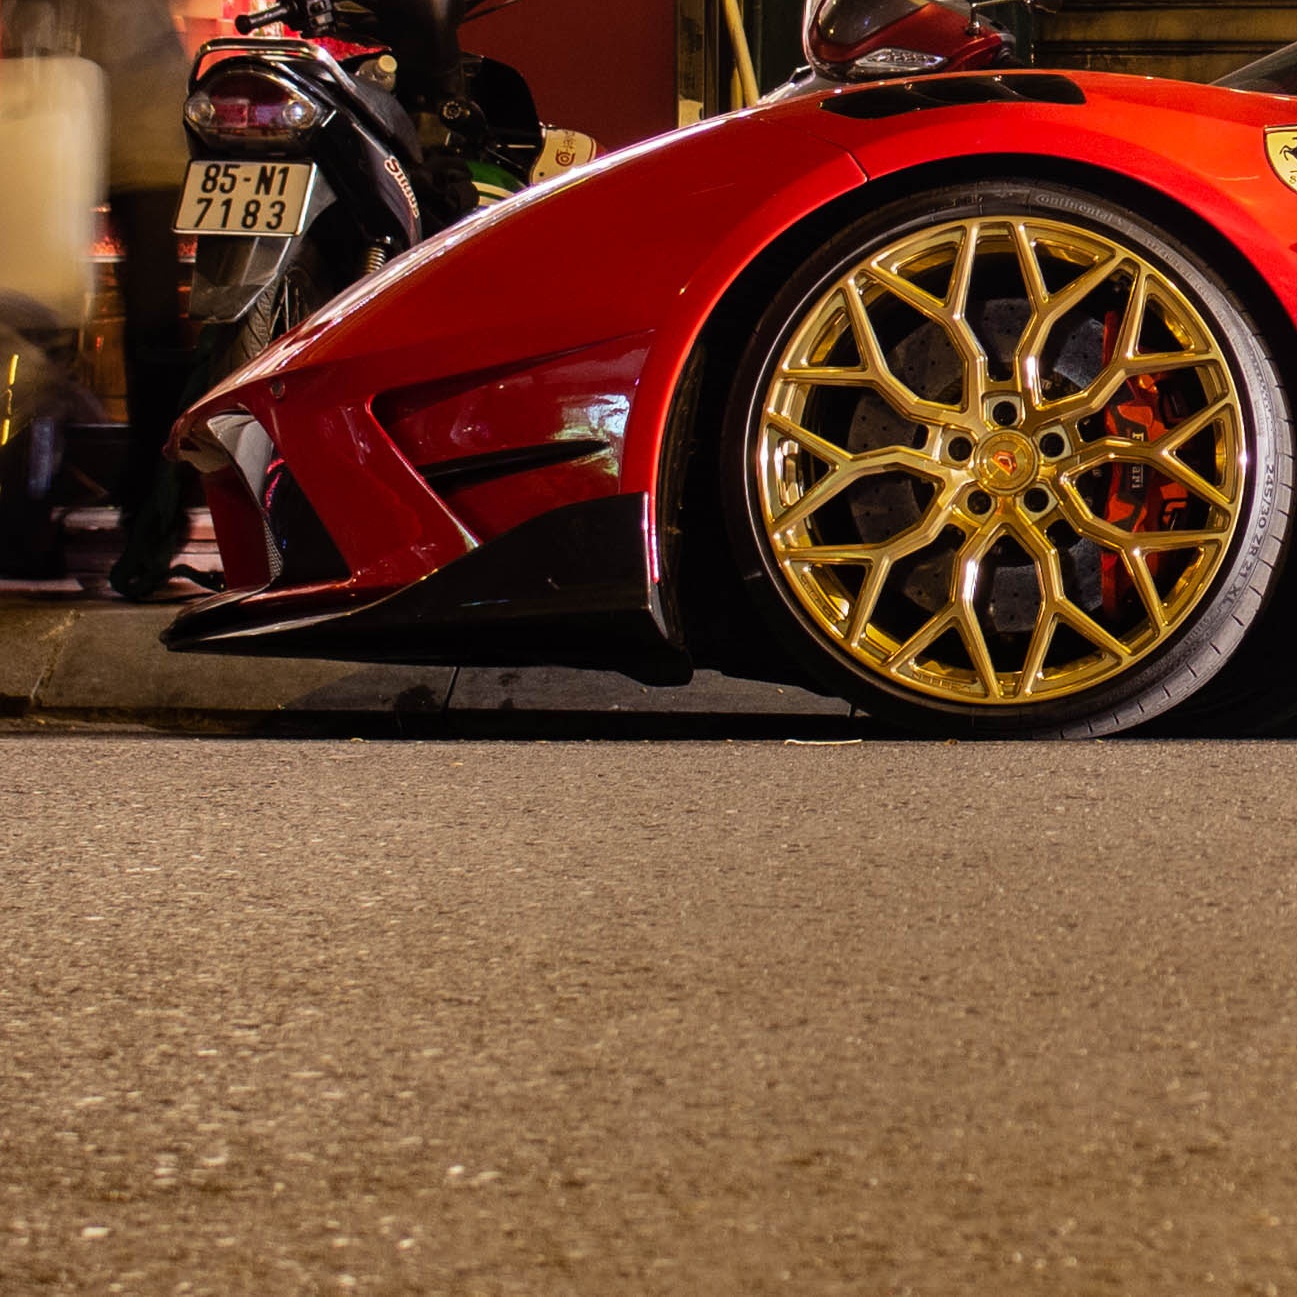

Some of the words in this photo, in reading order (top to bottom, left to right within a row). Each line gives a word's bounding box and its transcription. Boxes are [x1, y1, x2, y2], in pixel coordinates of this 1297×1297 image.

[201, 164, 290, 196] 85-N1
[194, 198, 286, 230] 7183
[1034, 192, 1115, 223] Continental
